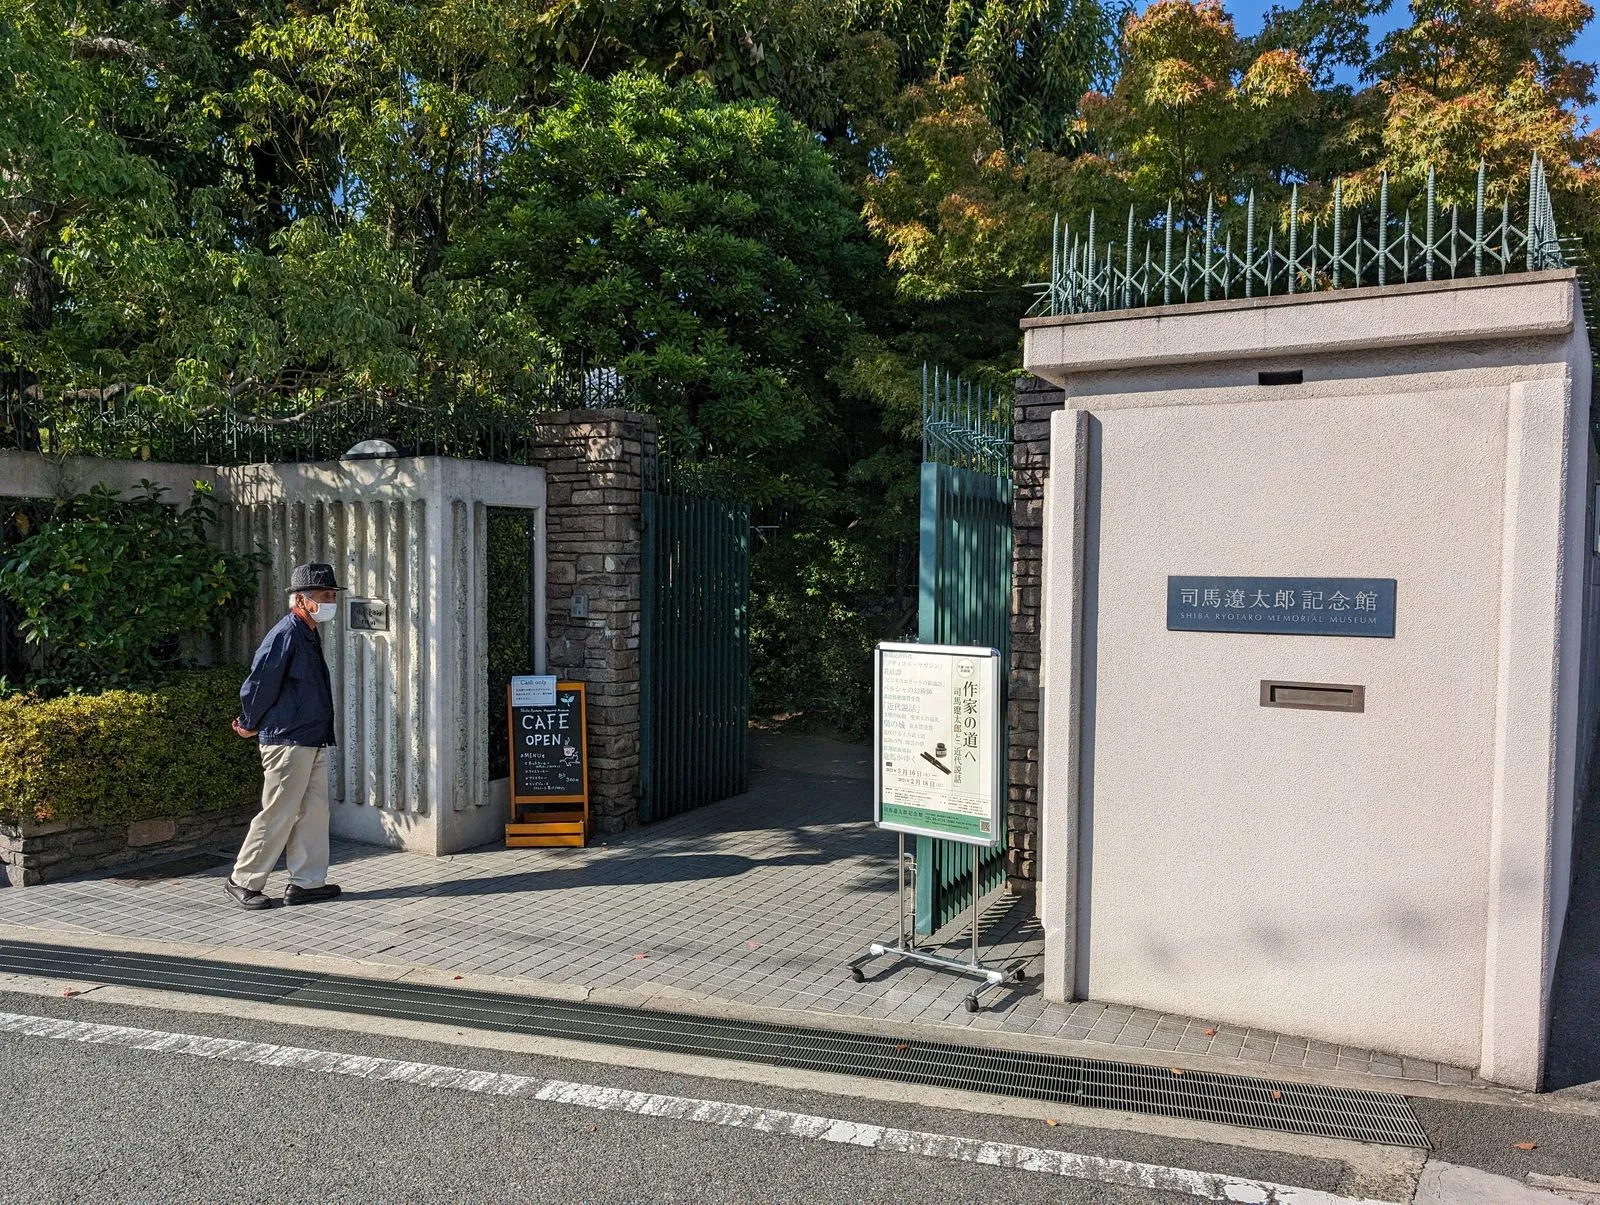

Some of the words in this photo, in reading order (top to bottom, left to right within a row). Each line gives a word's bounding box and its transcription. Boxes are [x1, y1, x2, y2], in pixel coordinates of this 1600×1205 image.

[1180, 588, 1379, 612] 司馬遼太郎記念館
[1180, 612, 1210, 620] SHIBA
[1215, 613, 1262, 621] RYOTARO
[1267, 614, 1323, 623] MEMORIAL
[1329, 616, 1377, 624] MUSEUM
[522, 713, 569, 730] CAFE
[962, 680, 978, 763] 作家の道へ
[525, 733, 561, 746] OPEN
